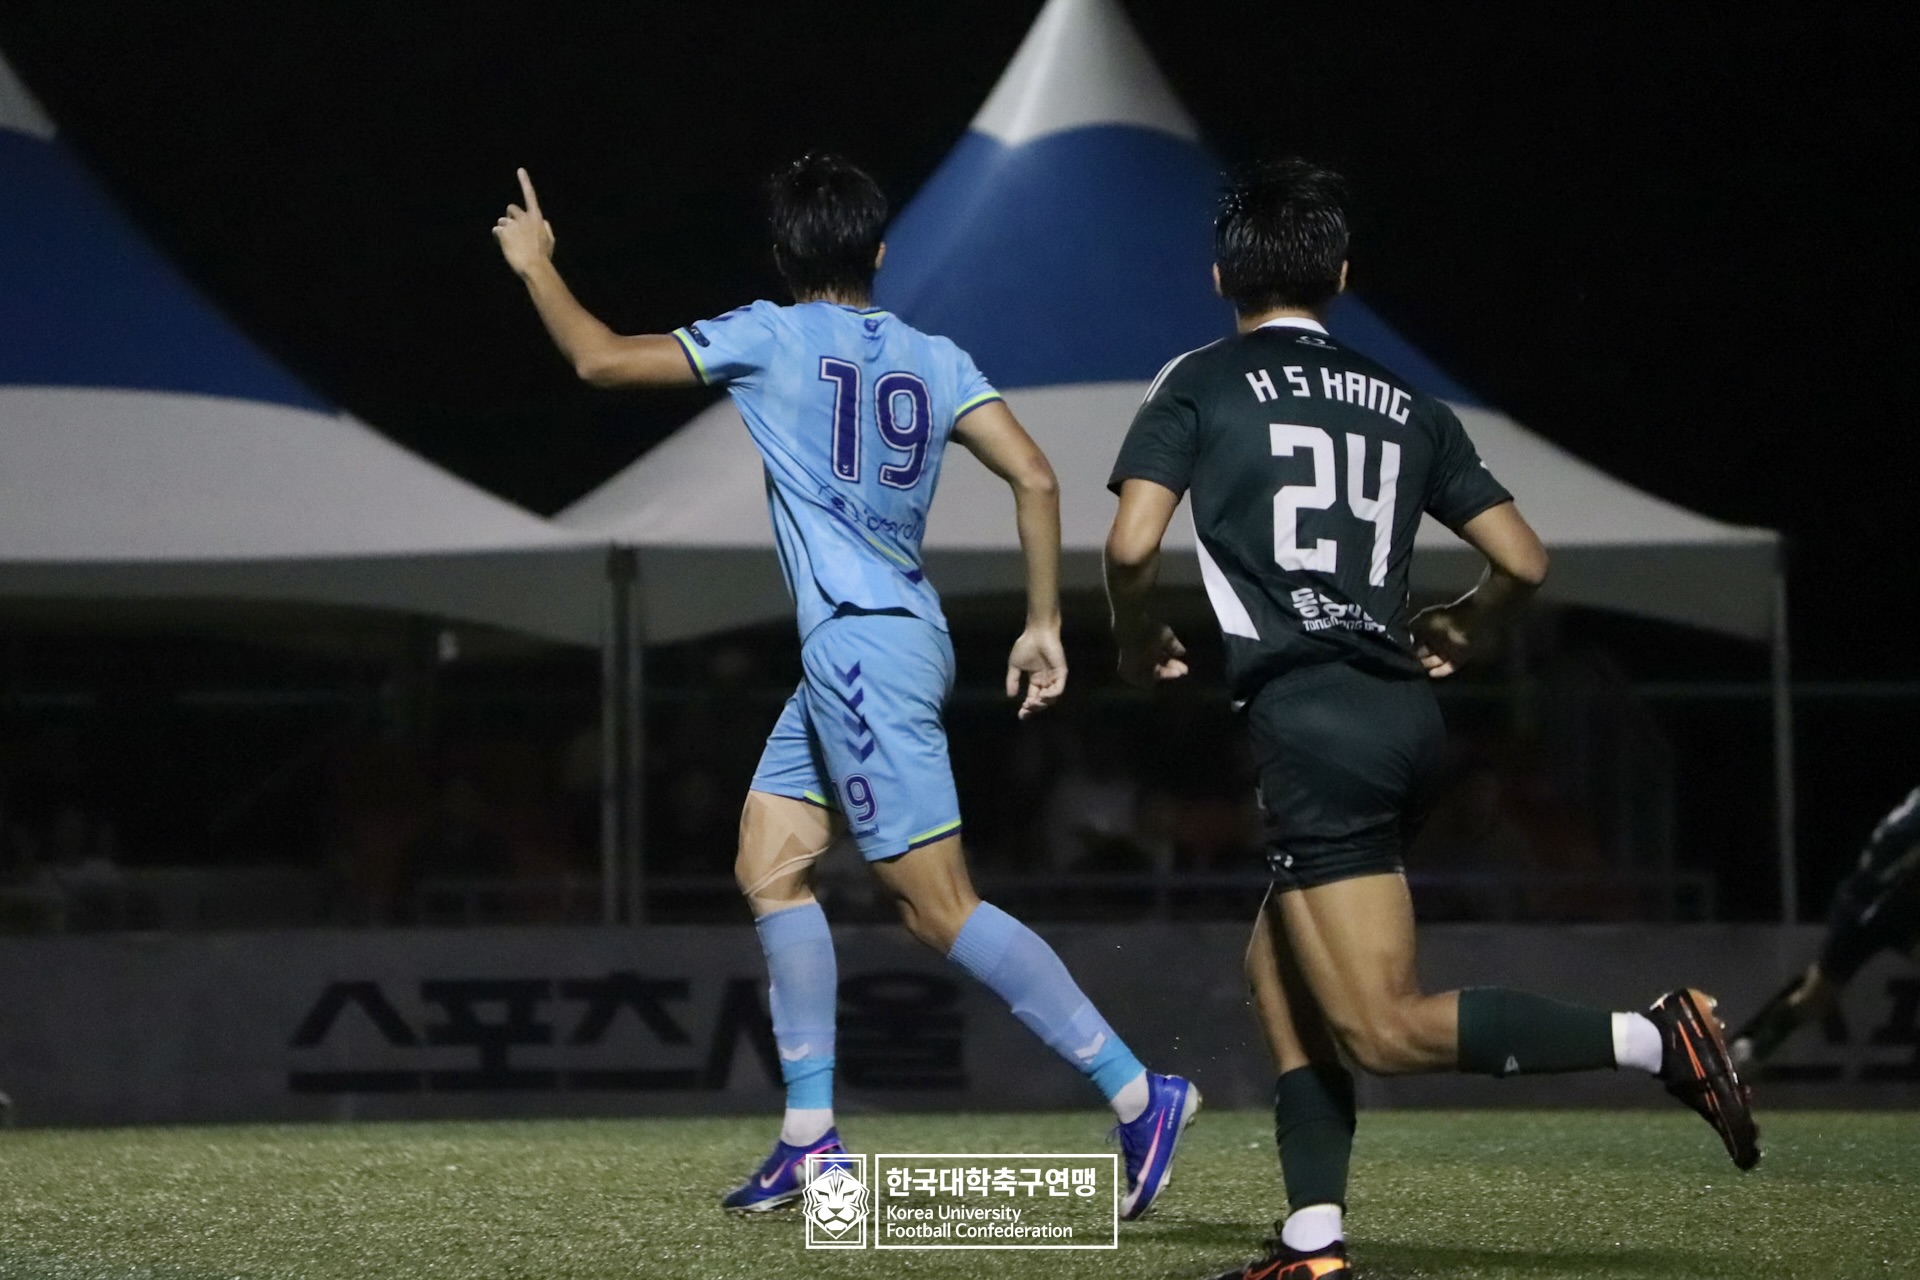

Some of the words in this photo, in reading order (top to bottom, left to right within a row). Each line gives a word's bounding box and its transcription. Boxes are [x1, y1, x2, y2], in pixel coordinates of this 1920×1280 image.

[819, 355, 933, 491] 19
[1245, 369, 1278, 402] H
[1283, 366, 1311, 397] S
[1320, 366, 1412, 425] KANG
[1269, 423, 1401, 587] 24
